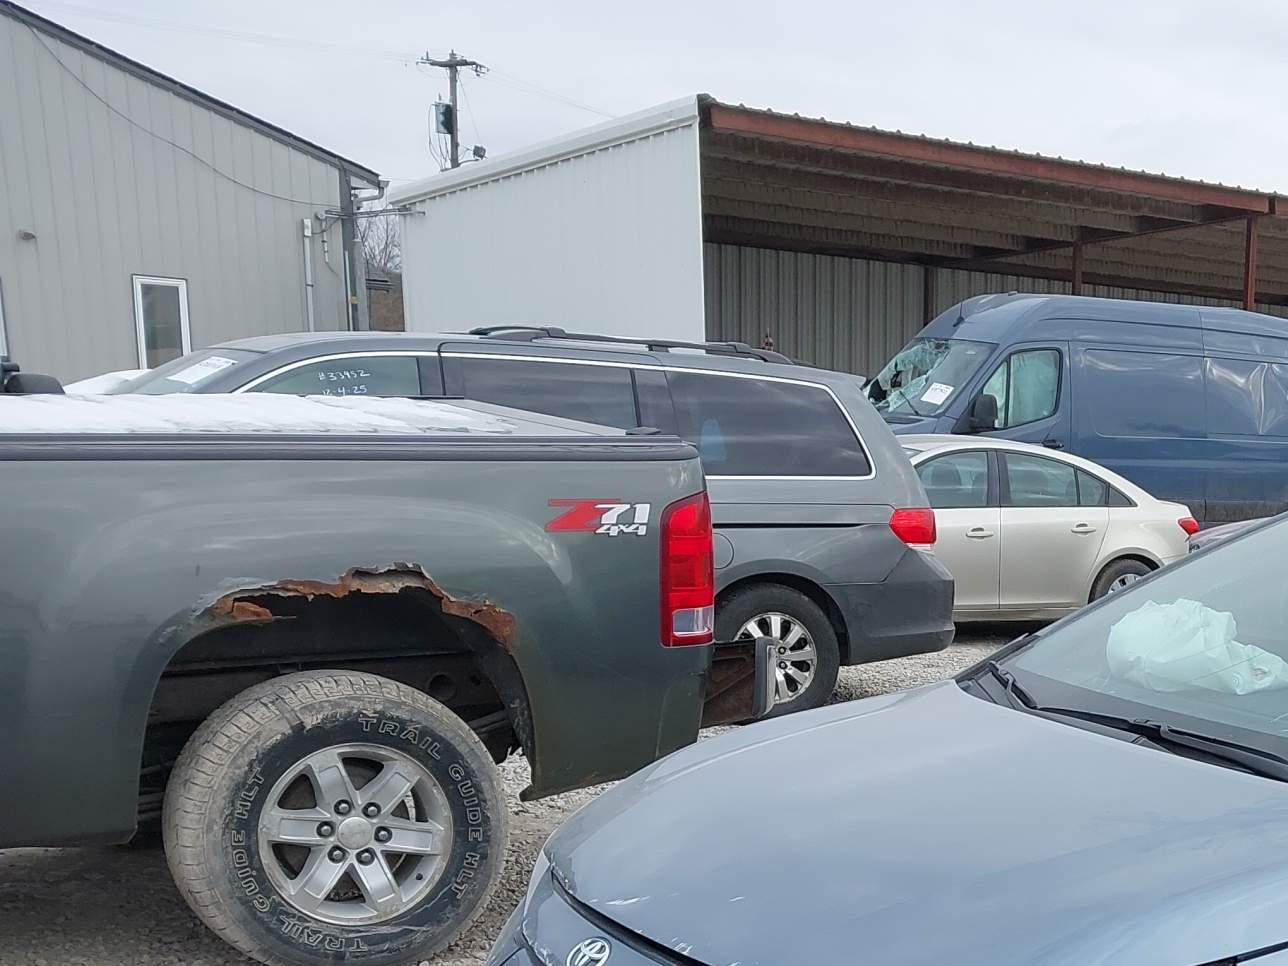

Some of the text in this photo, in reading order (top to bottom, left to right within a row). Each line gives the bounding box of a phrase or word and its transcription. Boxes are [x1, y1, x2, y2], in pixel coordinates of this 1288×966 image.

[544, 499, 651, 533] Z71
[232, 767, 368, 951] TRAIL GUIDE HLT
[358, 717, 484, 900] TRAIL GUIDE HLT
